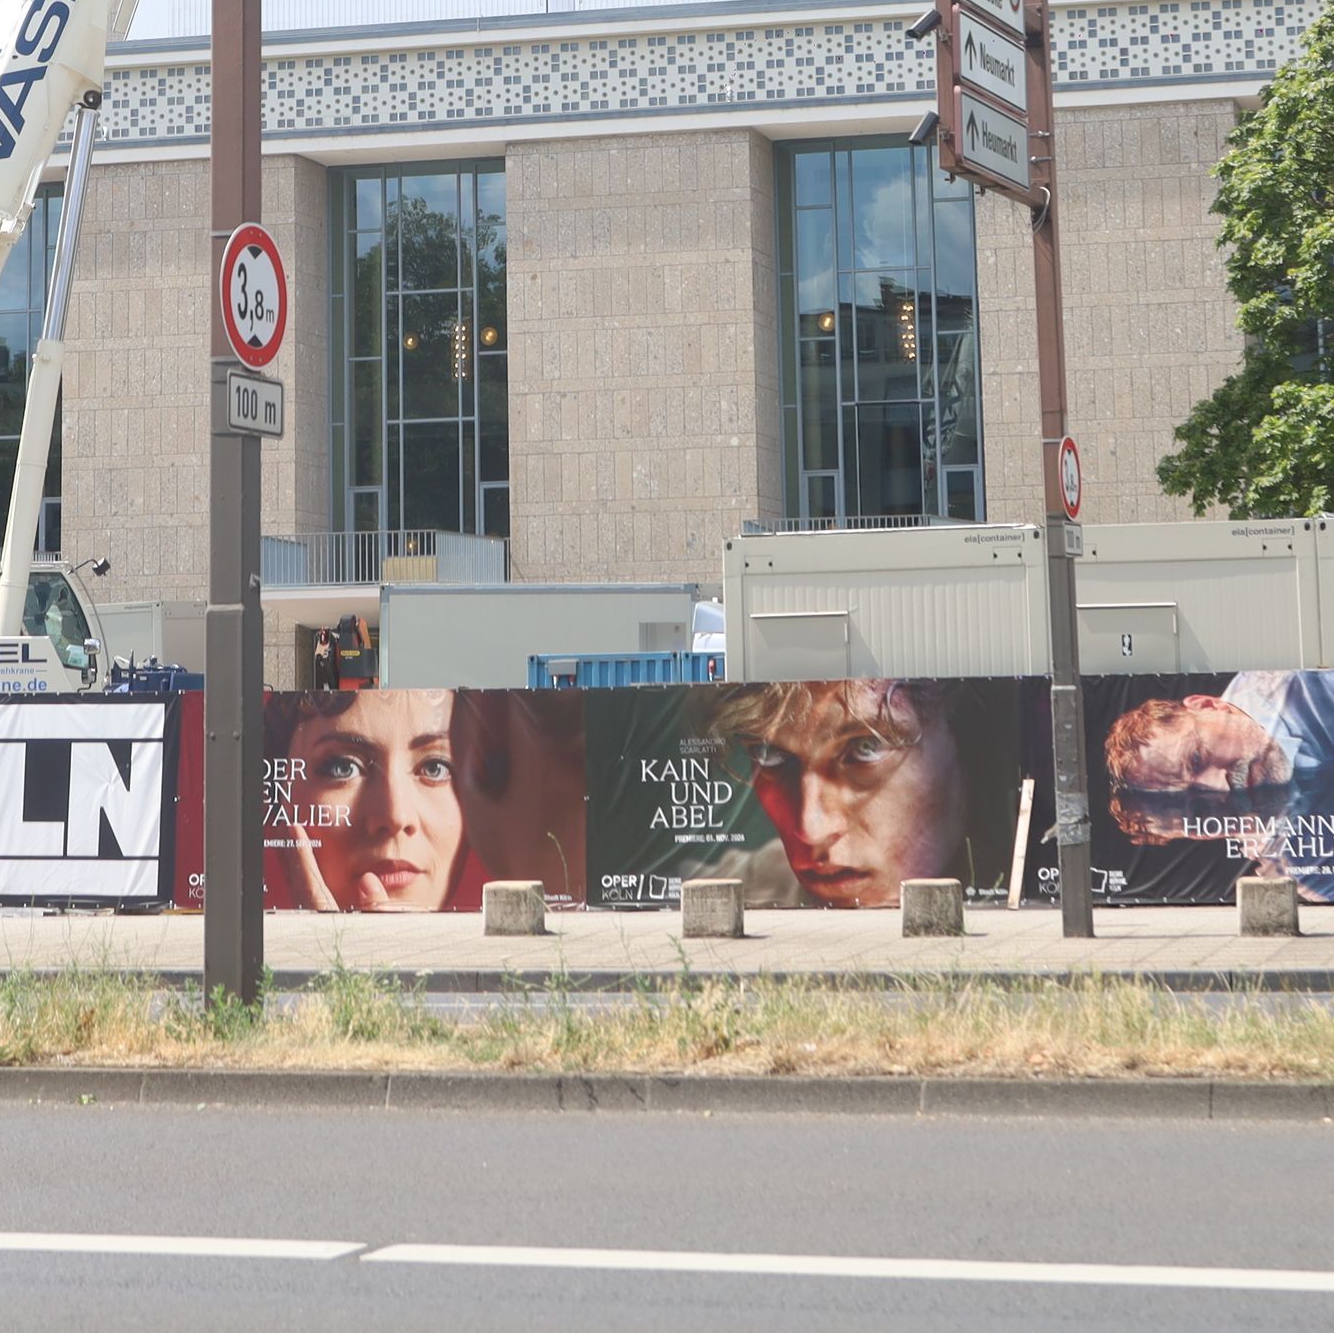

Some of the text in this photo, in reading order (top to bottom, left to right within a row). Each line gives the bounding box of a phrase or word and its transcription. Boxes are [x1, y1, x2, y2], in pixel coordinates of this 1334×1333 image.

[979, 41, 1016, 88] Neumarkt
[981, 119, 1018, 164] Heumarkt
[235, 385, 277, 426] 100 m
[964, 531, 1025, 545] ela[container]
[1231, 525, 1296, 538] ela[container]
[640, 757, 710, 783] KAIN
[670, 781, 733, 805] UND
[649, 804, 724, 829] ABEL
[601, 874, 638, 887] OPER
[601, 885, 634, 901] KÖLN
